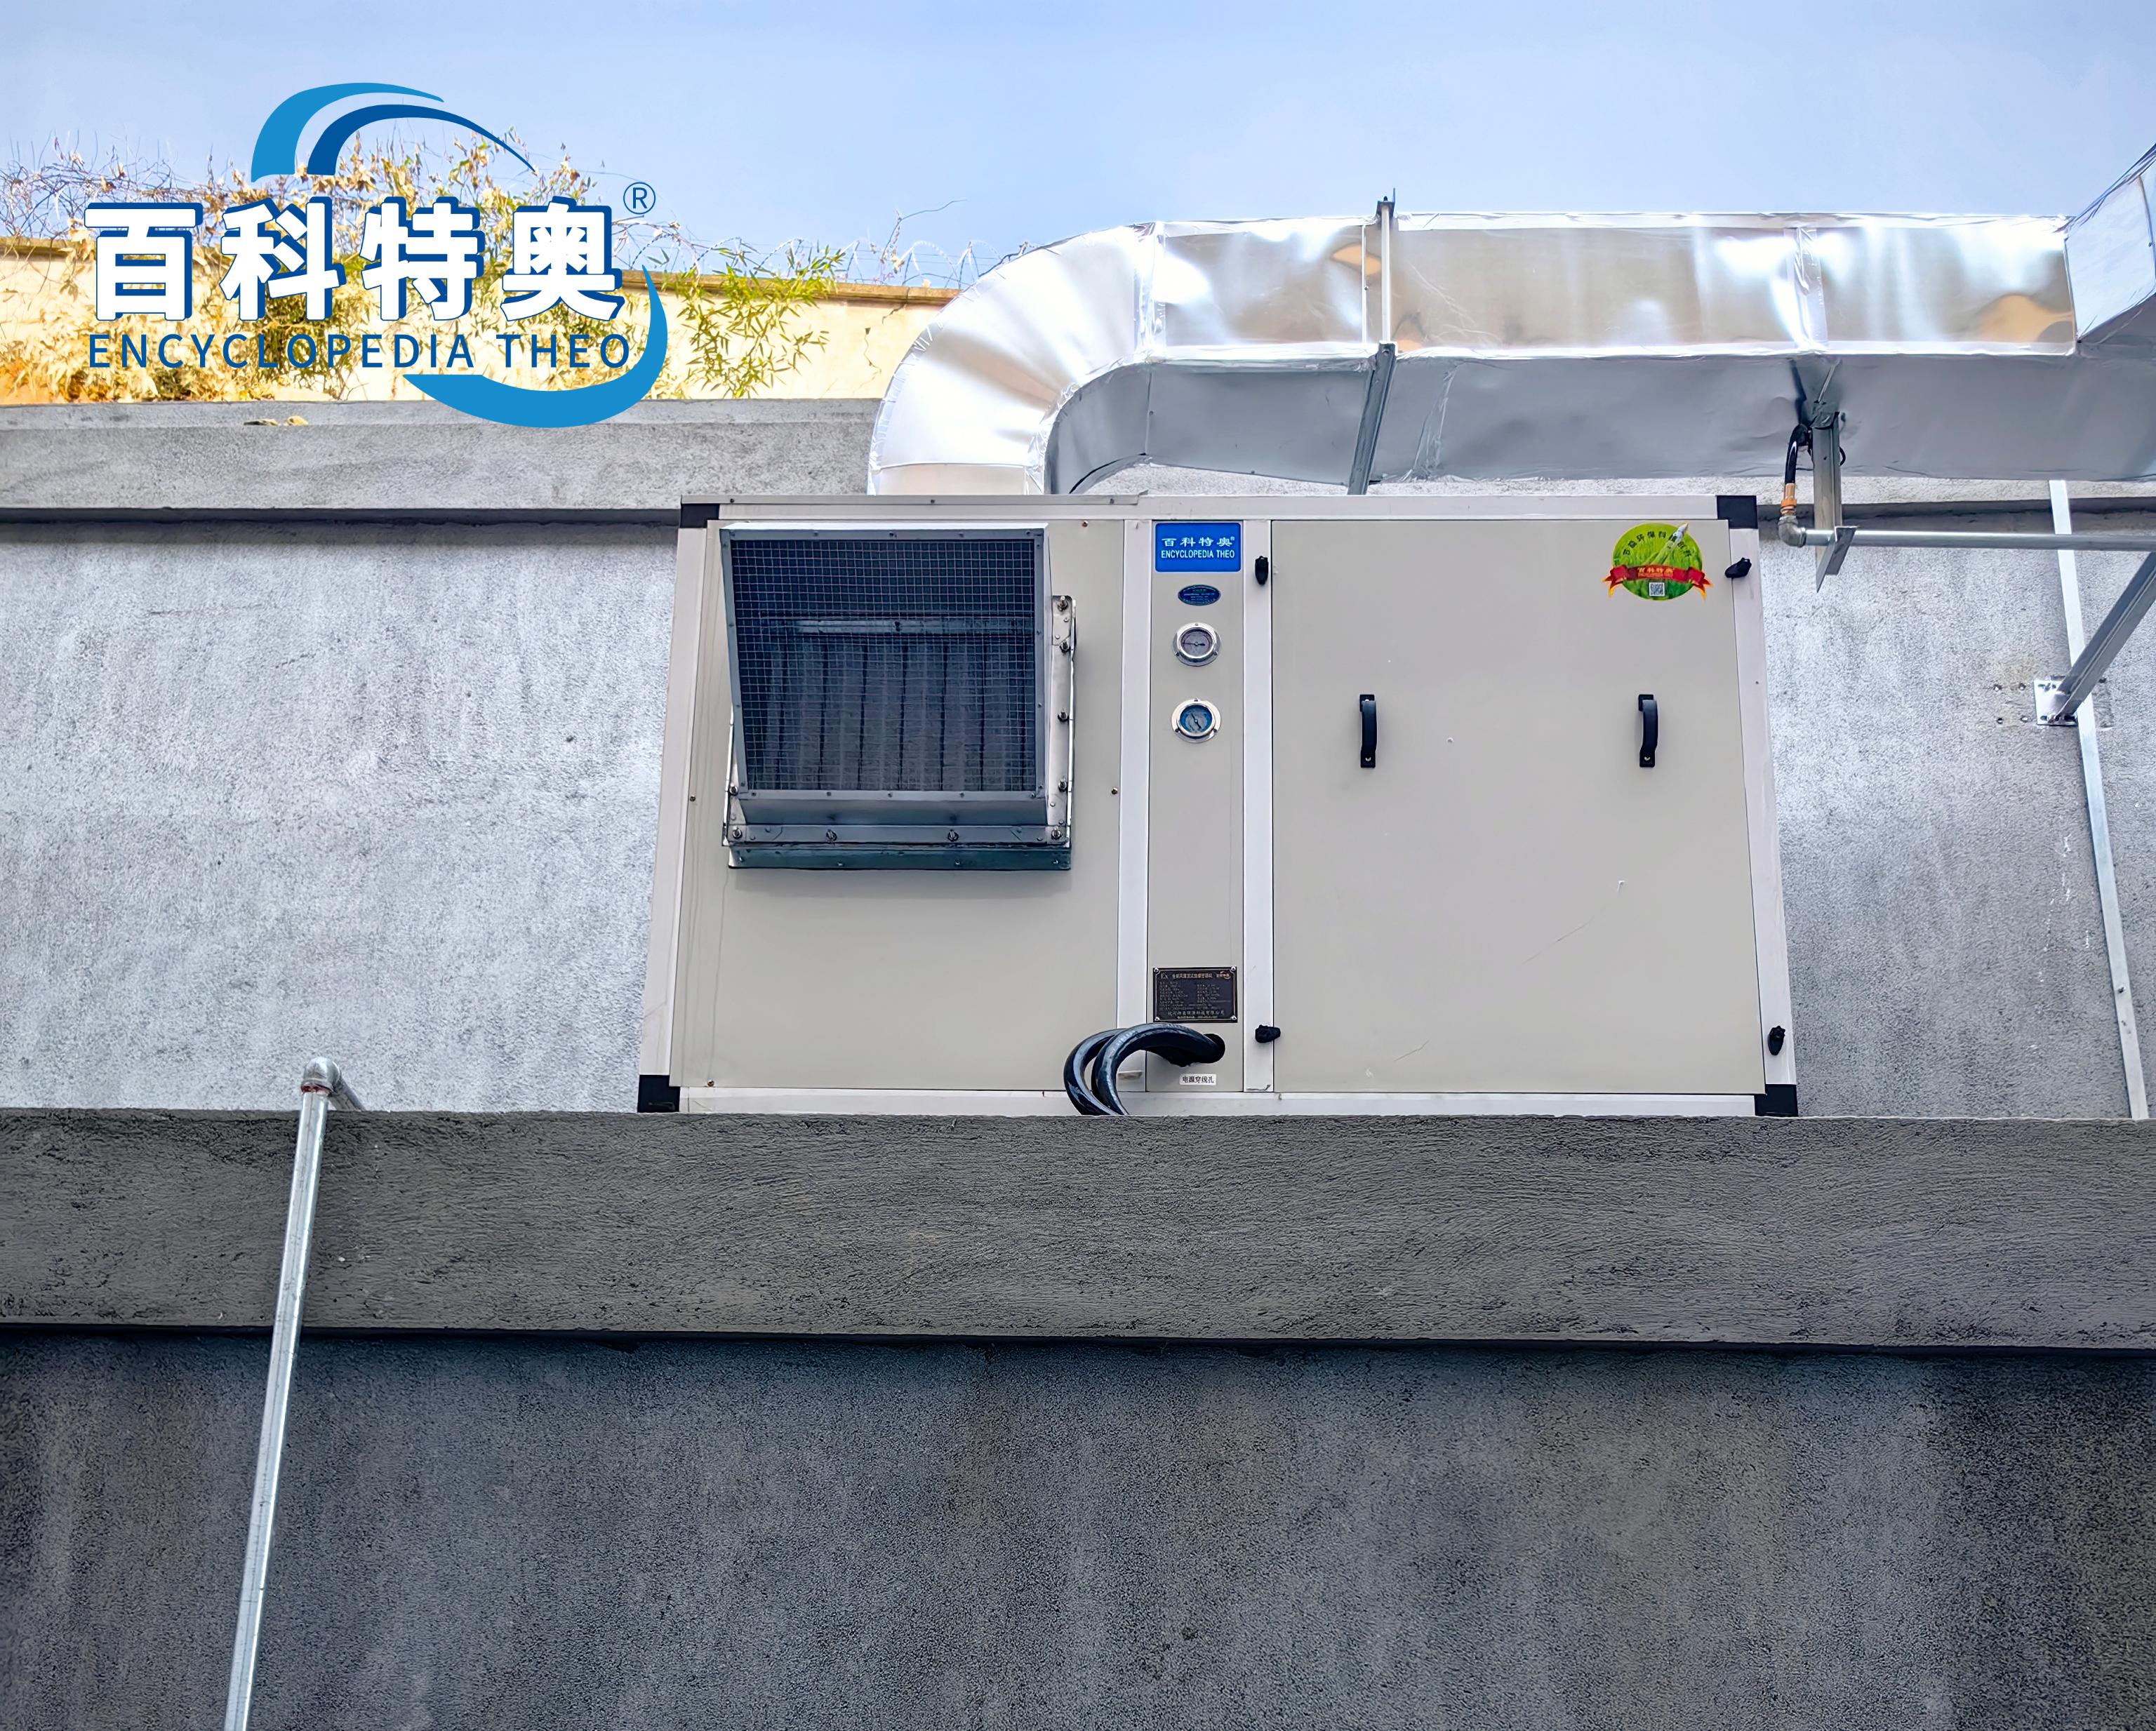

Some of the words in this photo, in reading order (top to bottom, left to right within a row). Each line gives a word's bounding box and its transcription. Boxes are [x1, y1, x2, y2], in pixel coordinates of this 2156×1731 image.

[1161, 549, 1214, 559] ENCYCLOPEDIA
[1216, 549, 1235, 559] THEO
[1182, 1075, 1214, 1084] 电源穿线孔
